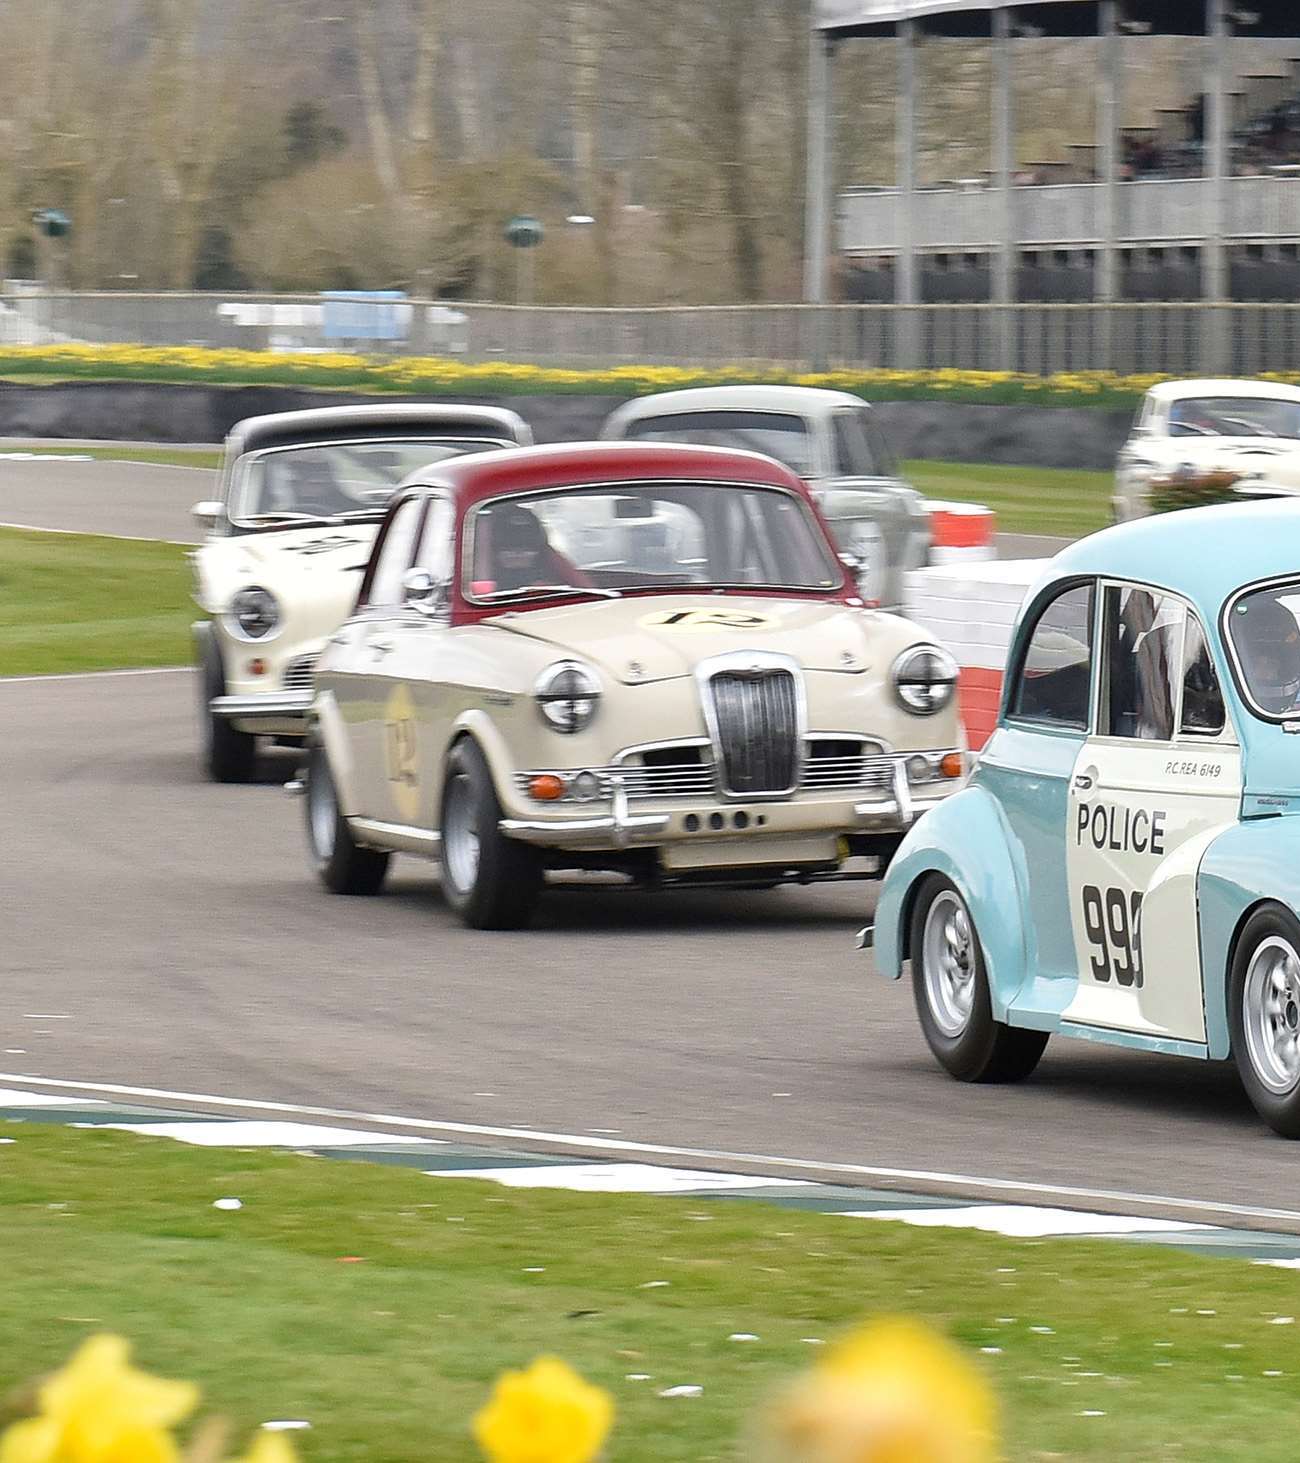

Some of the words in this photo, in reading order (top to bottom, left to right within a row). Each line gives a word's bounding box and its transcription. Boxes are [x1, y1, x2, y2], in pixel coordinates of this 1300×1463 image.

[647, 611, 766, 629] 12
[1200, 763, 1221, 778] 6149
[1077, 803, 1166, 855] POLICE
